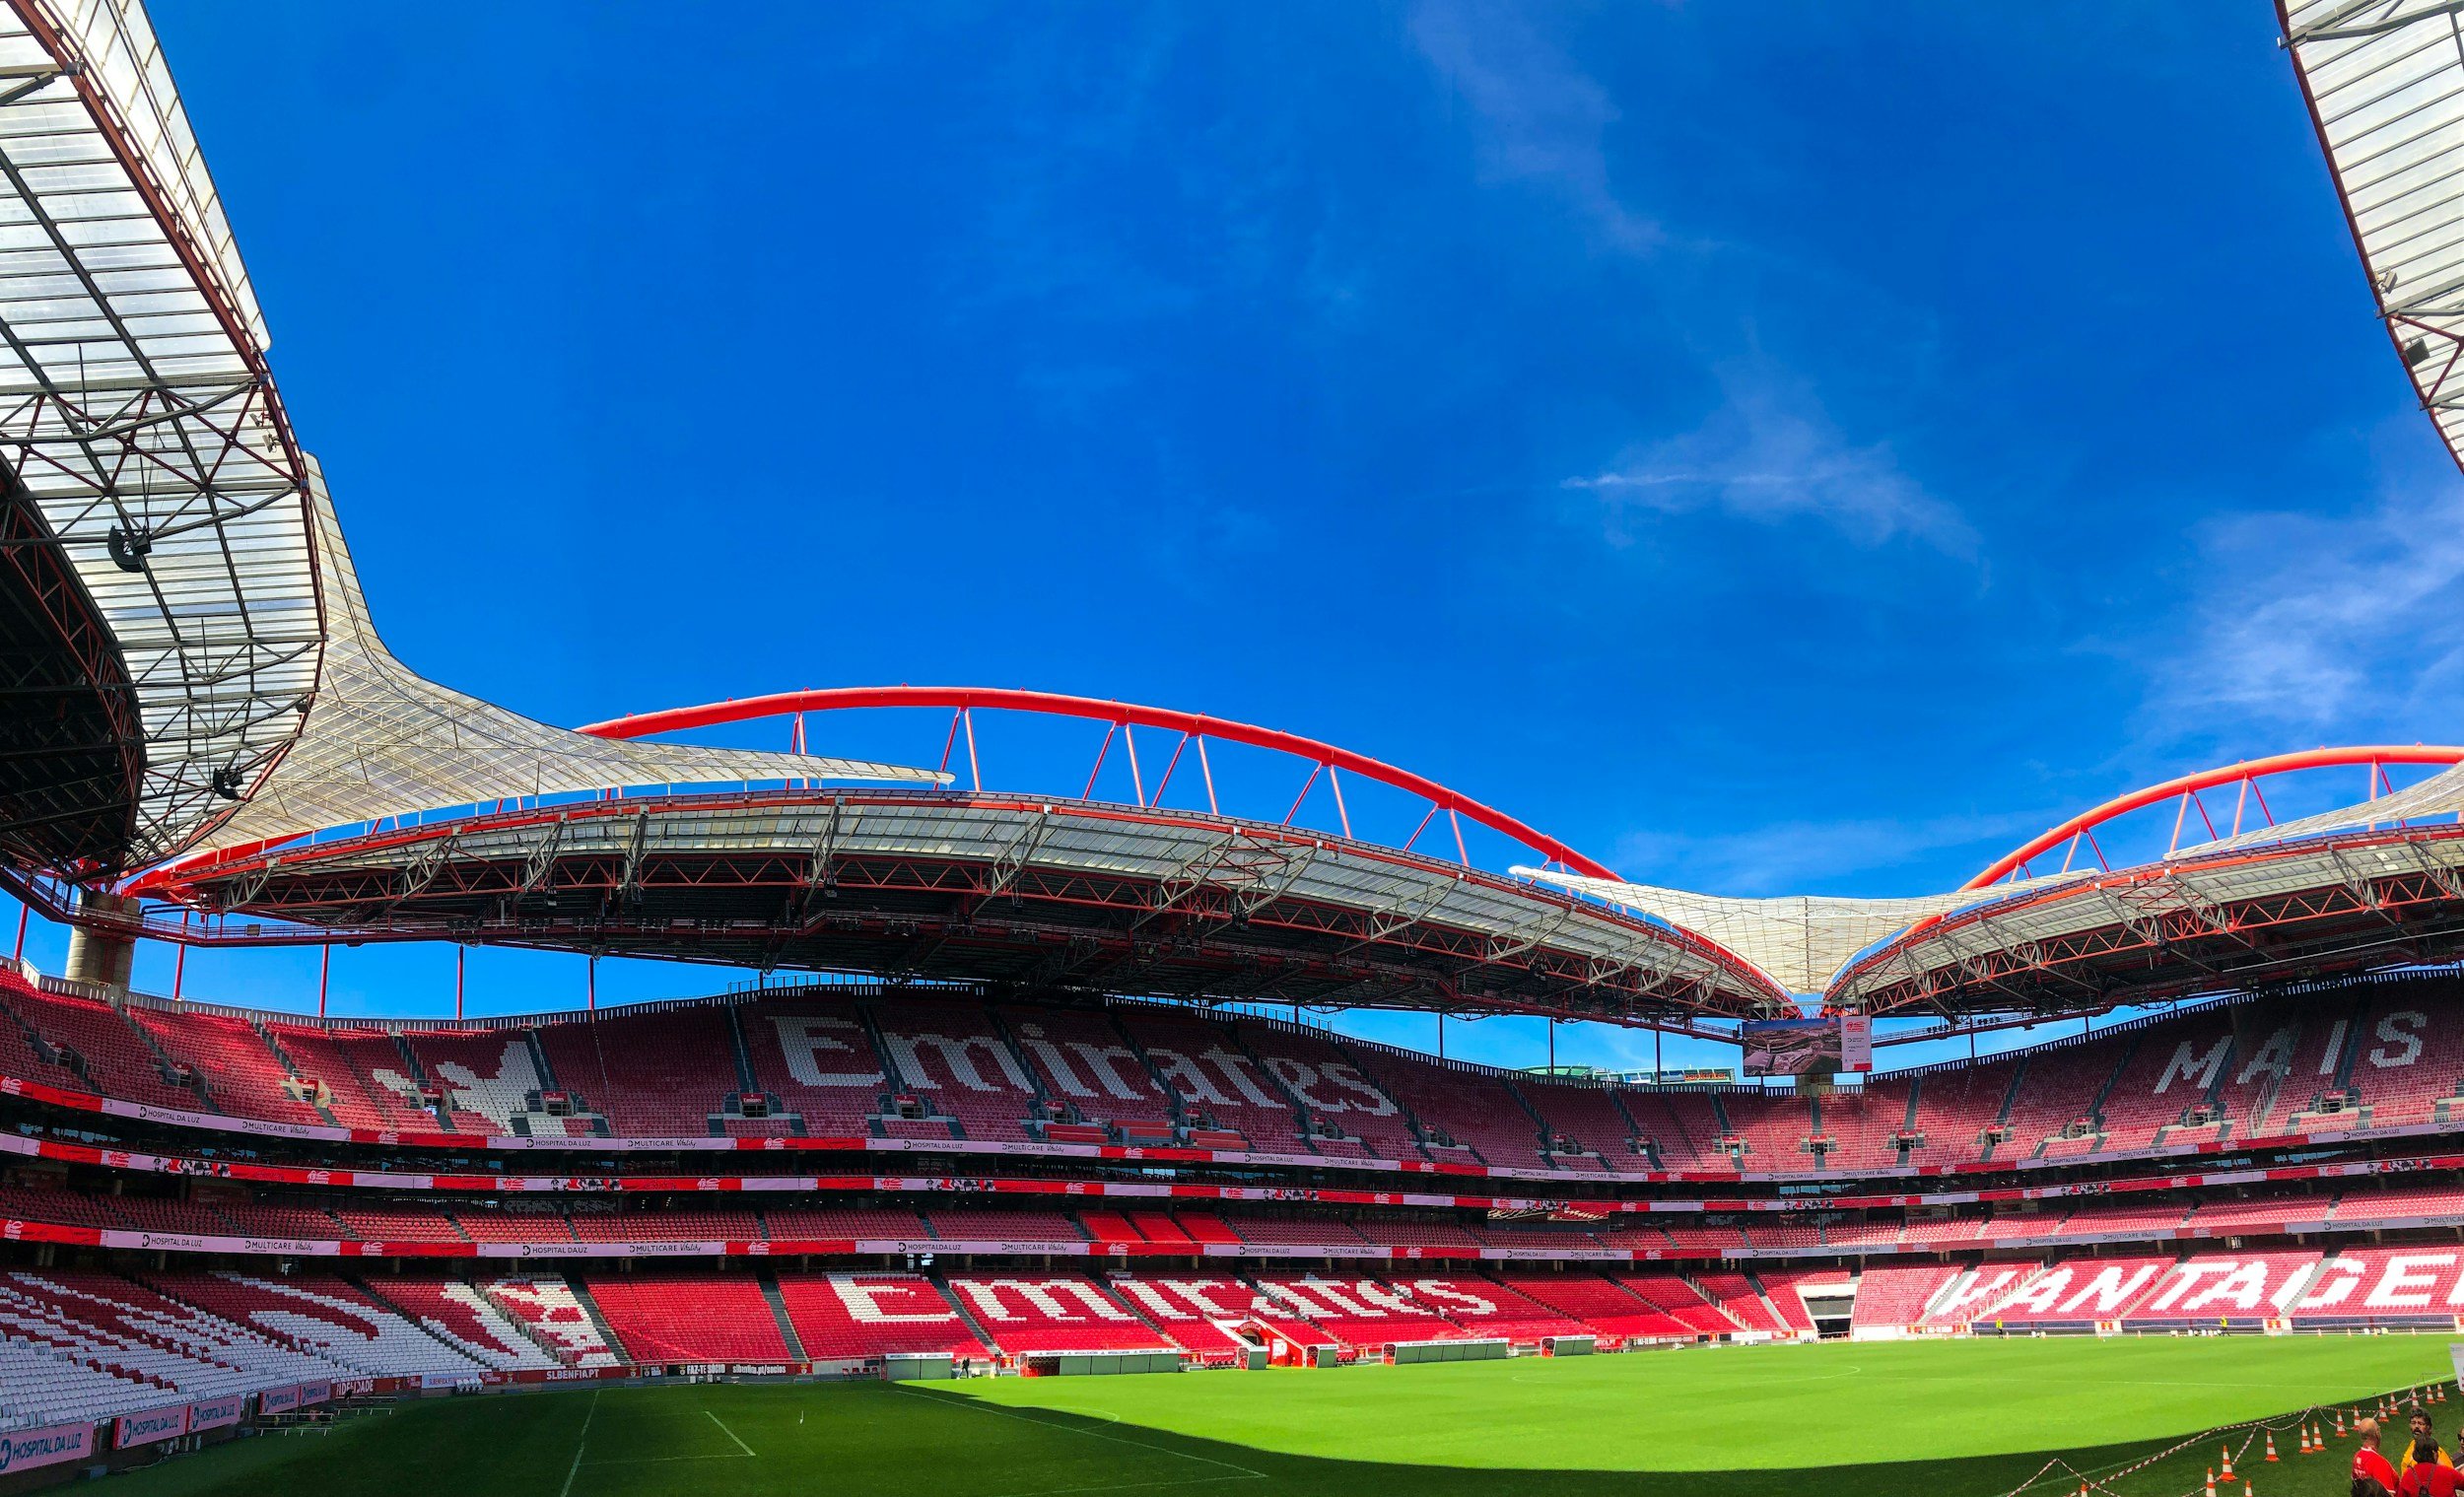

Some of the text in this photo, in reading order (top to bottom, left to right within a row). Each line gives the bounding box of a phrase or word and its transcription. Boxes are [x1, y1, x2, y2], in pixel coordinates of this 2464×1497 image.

[765, 1015, 1399, 1117] Emirates
[2154, 1011, 2428, 1094] MAIS
[148, 1110, 200, 1123] HOSPITAL DA LUZ
[248, 1123, 287, 1133] MULTICARE
[826, 1270, 1497, 1324] Emirates
[1923, 1253, 2464, 1315] VANTAGE
[687, 1365, 707, 1375] FAZ-TE
[708, 1364, 725, 1374] SÓCIO
[132, 1415, 178, 1436] HOSPITAL DA LUZ
[12, 1433, 82, 1460] HOSPITAL DA LUZ
